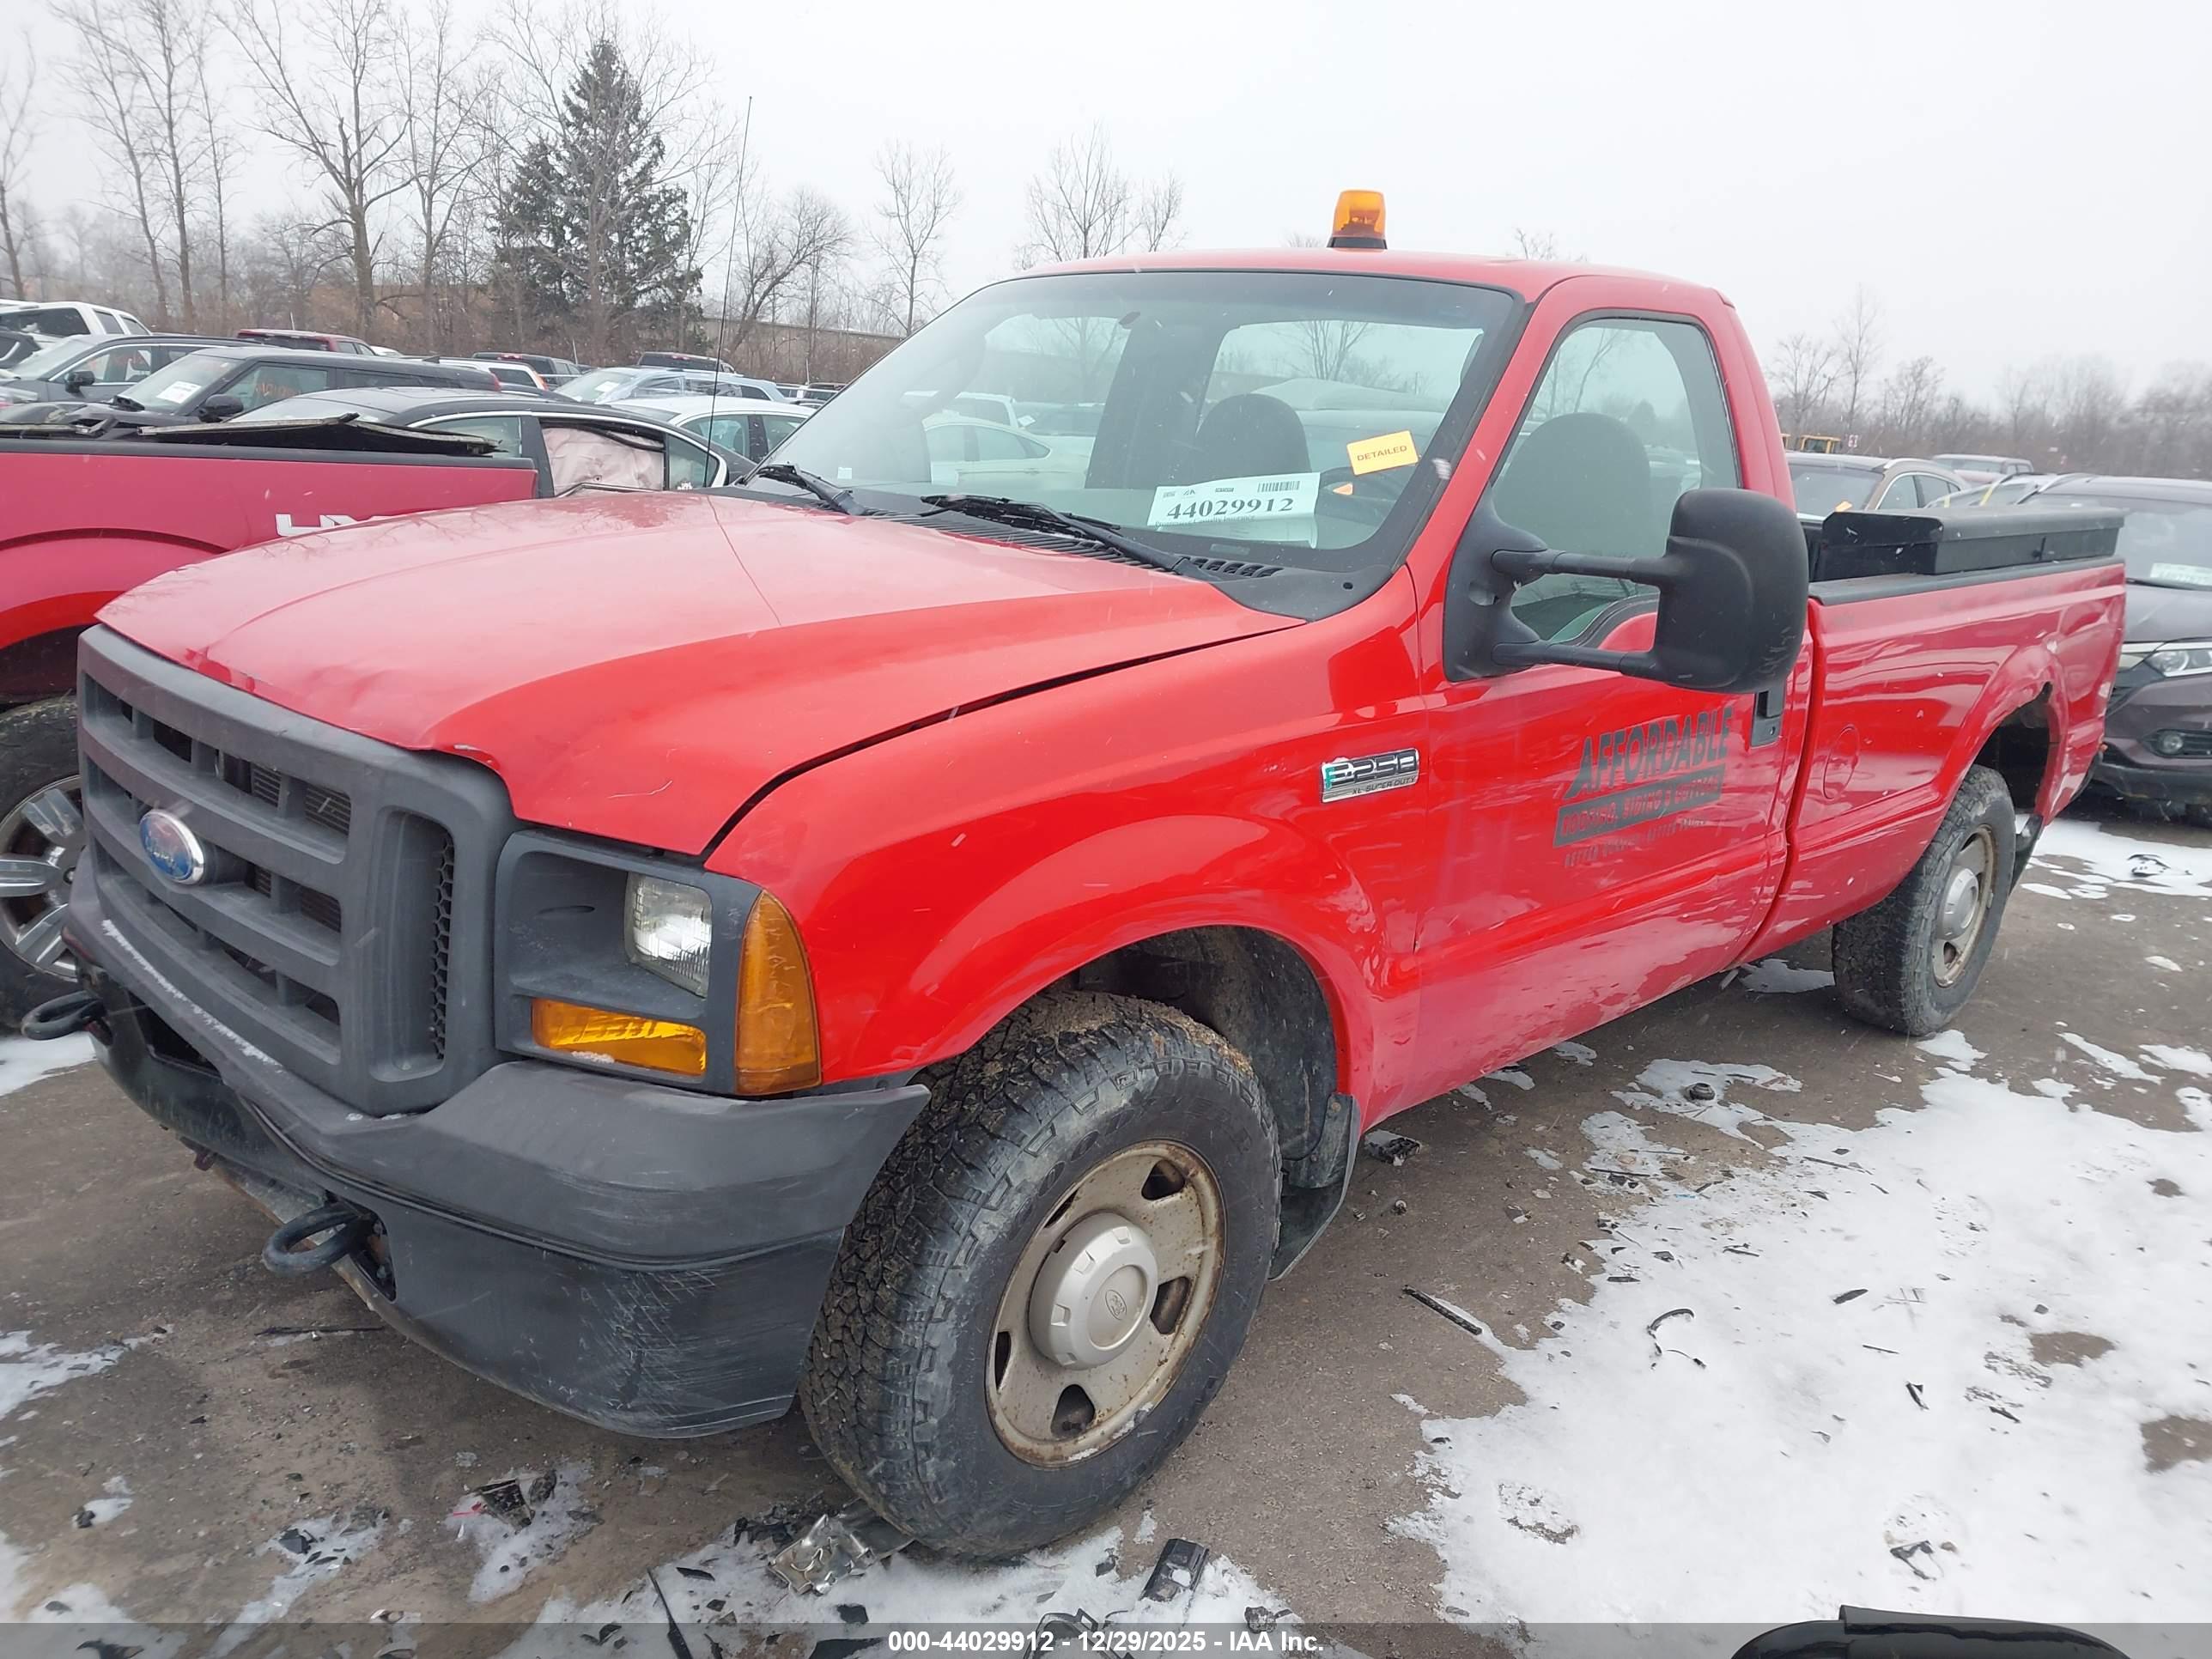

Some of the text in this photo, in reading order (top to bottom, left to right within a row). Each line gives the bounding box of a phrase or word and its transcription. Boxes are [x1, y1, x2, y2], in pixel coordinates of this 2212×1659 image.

[1356, 444, 1408, 461] DETAILED
[1166, 497, 1294, 520] 44029912
[1564, 706, 1734, 800] AFFORDABLE
[1365, 781, 1393, 793] SUPER
[1394, 775, 1416, 787] DUTY
